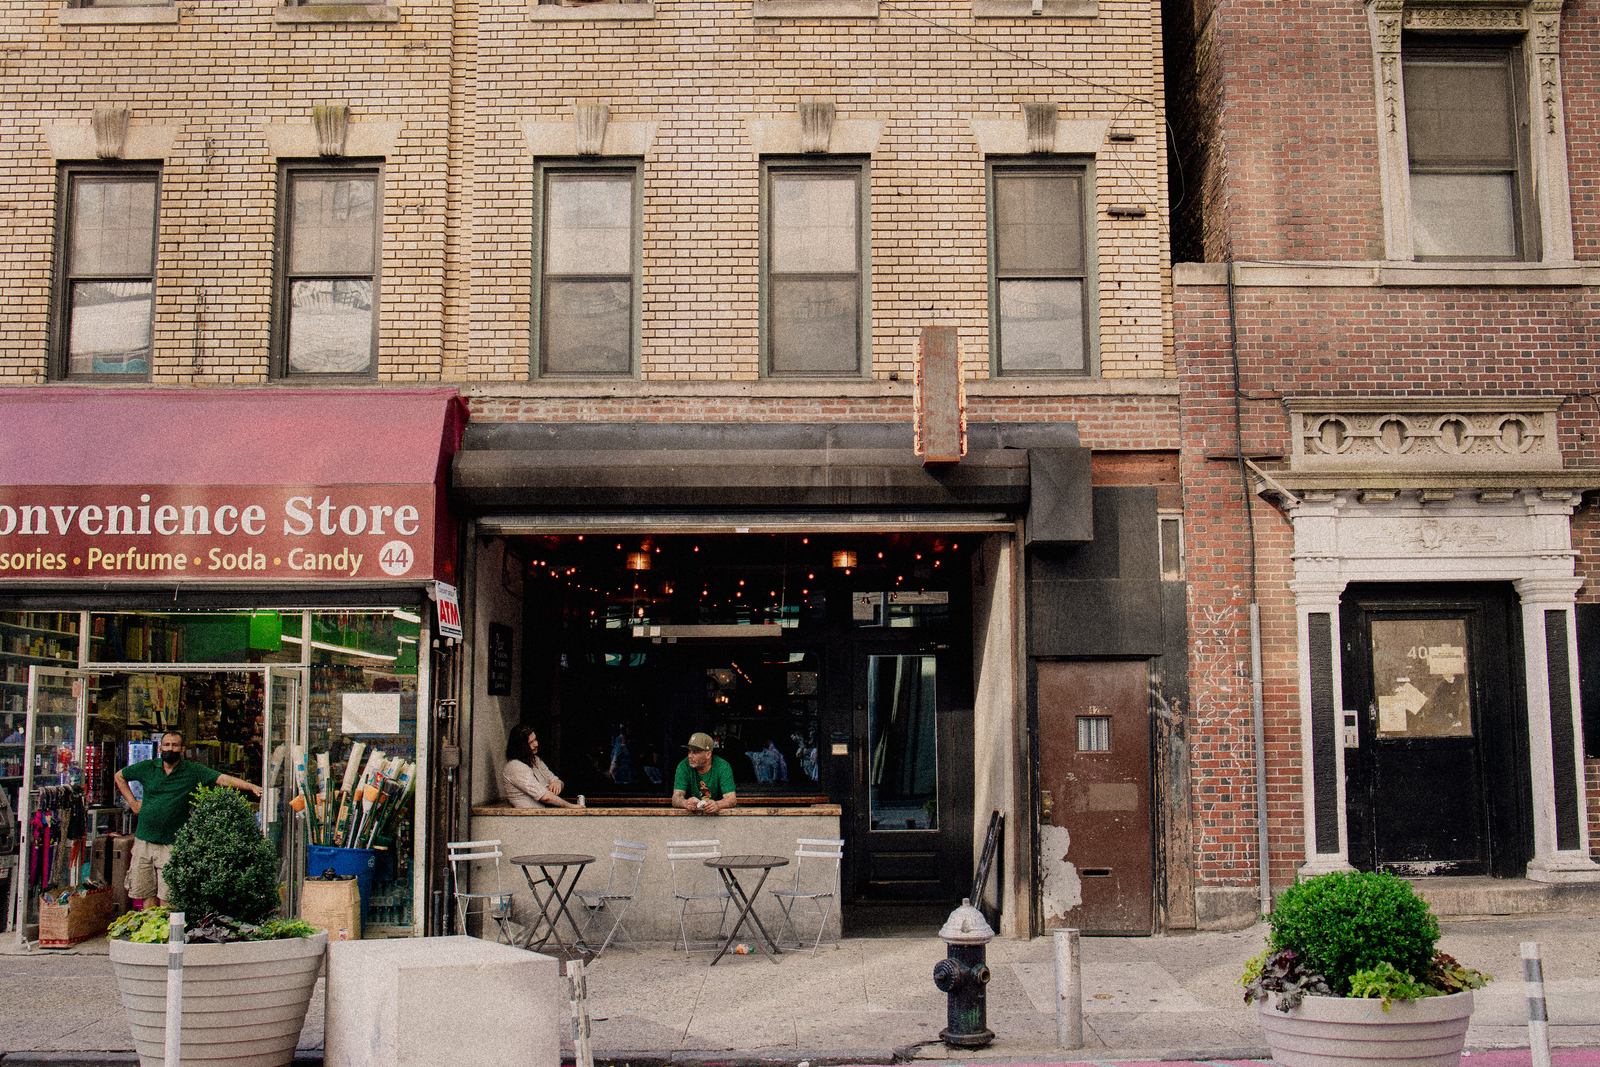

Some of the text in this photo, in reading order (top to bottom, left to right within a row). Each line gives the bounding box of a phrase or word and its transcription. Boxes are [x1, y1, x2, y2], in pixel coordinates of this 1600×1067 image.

[0, 494, 420, 536] onvenience Store
[0, 547, 363, 577] sories Perfume Soda Candy
[382, 548, 409, 568] 44
[440, 599, 460, 627] ATM
[1407, 646, 1428, 660] 40
